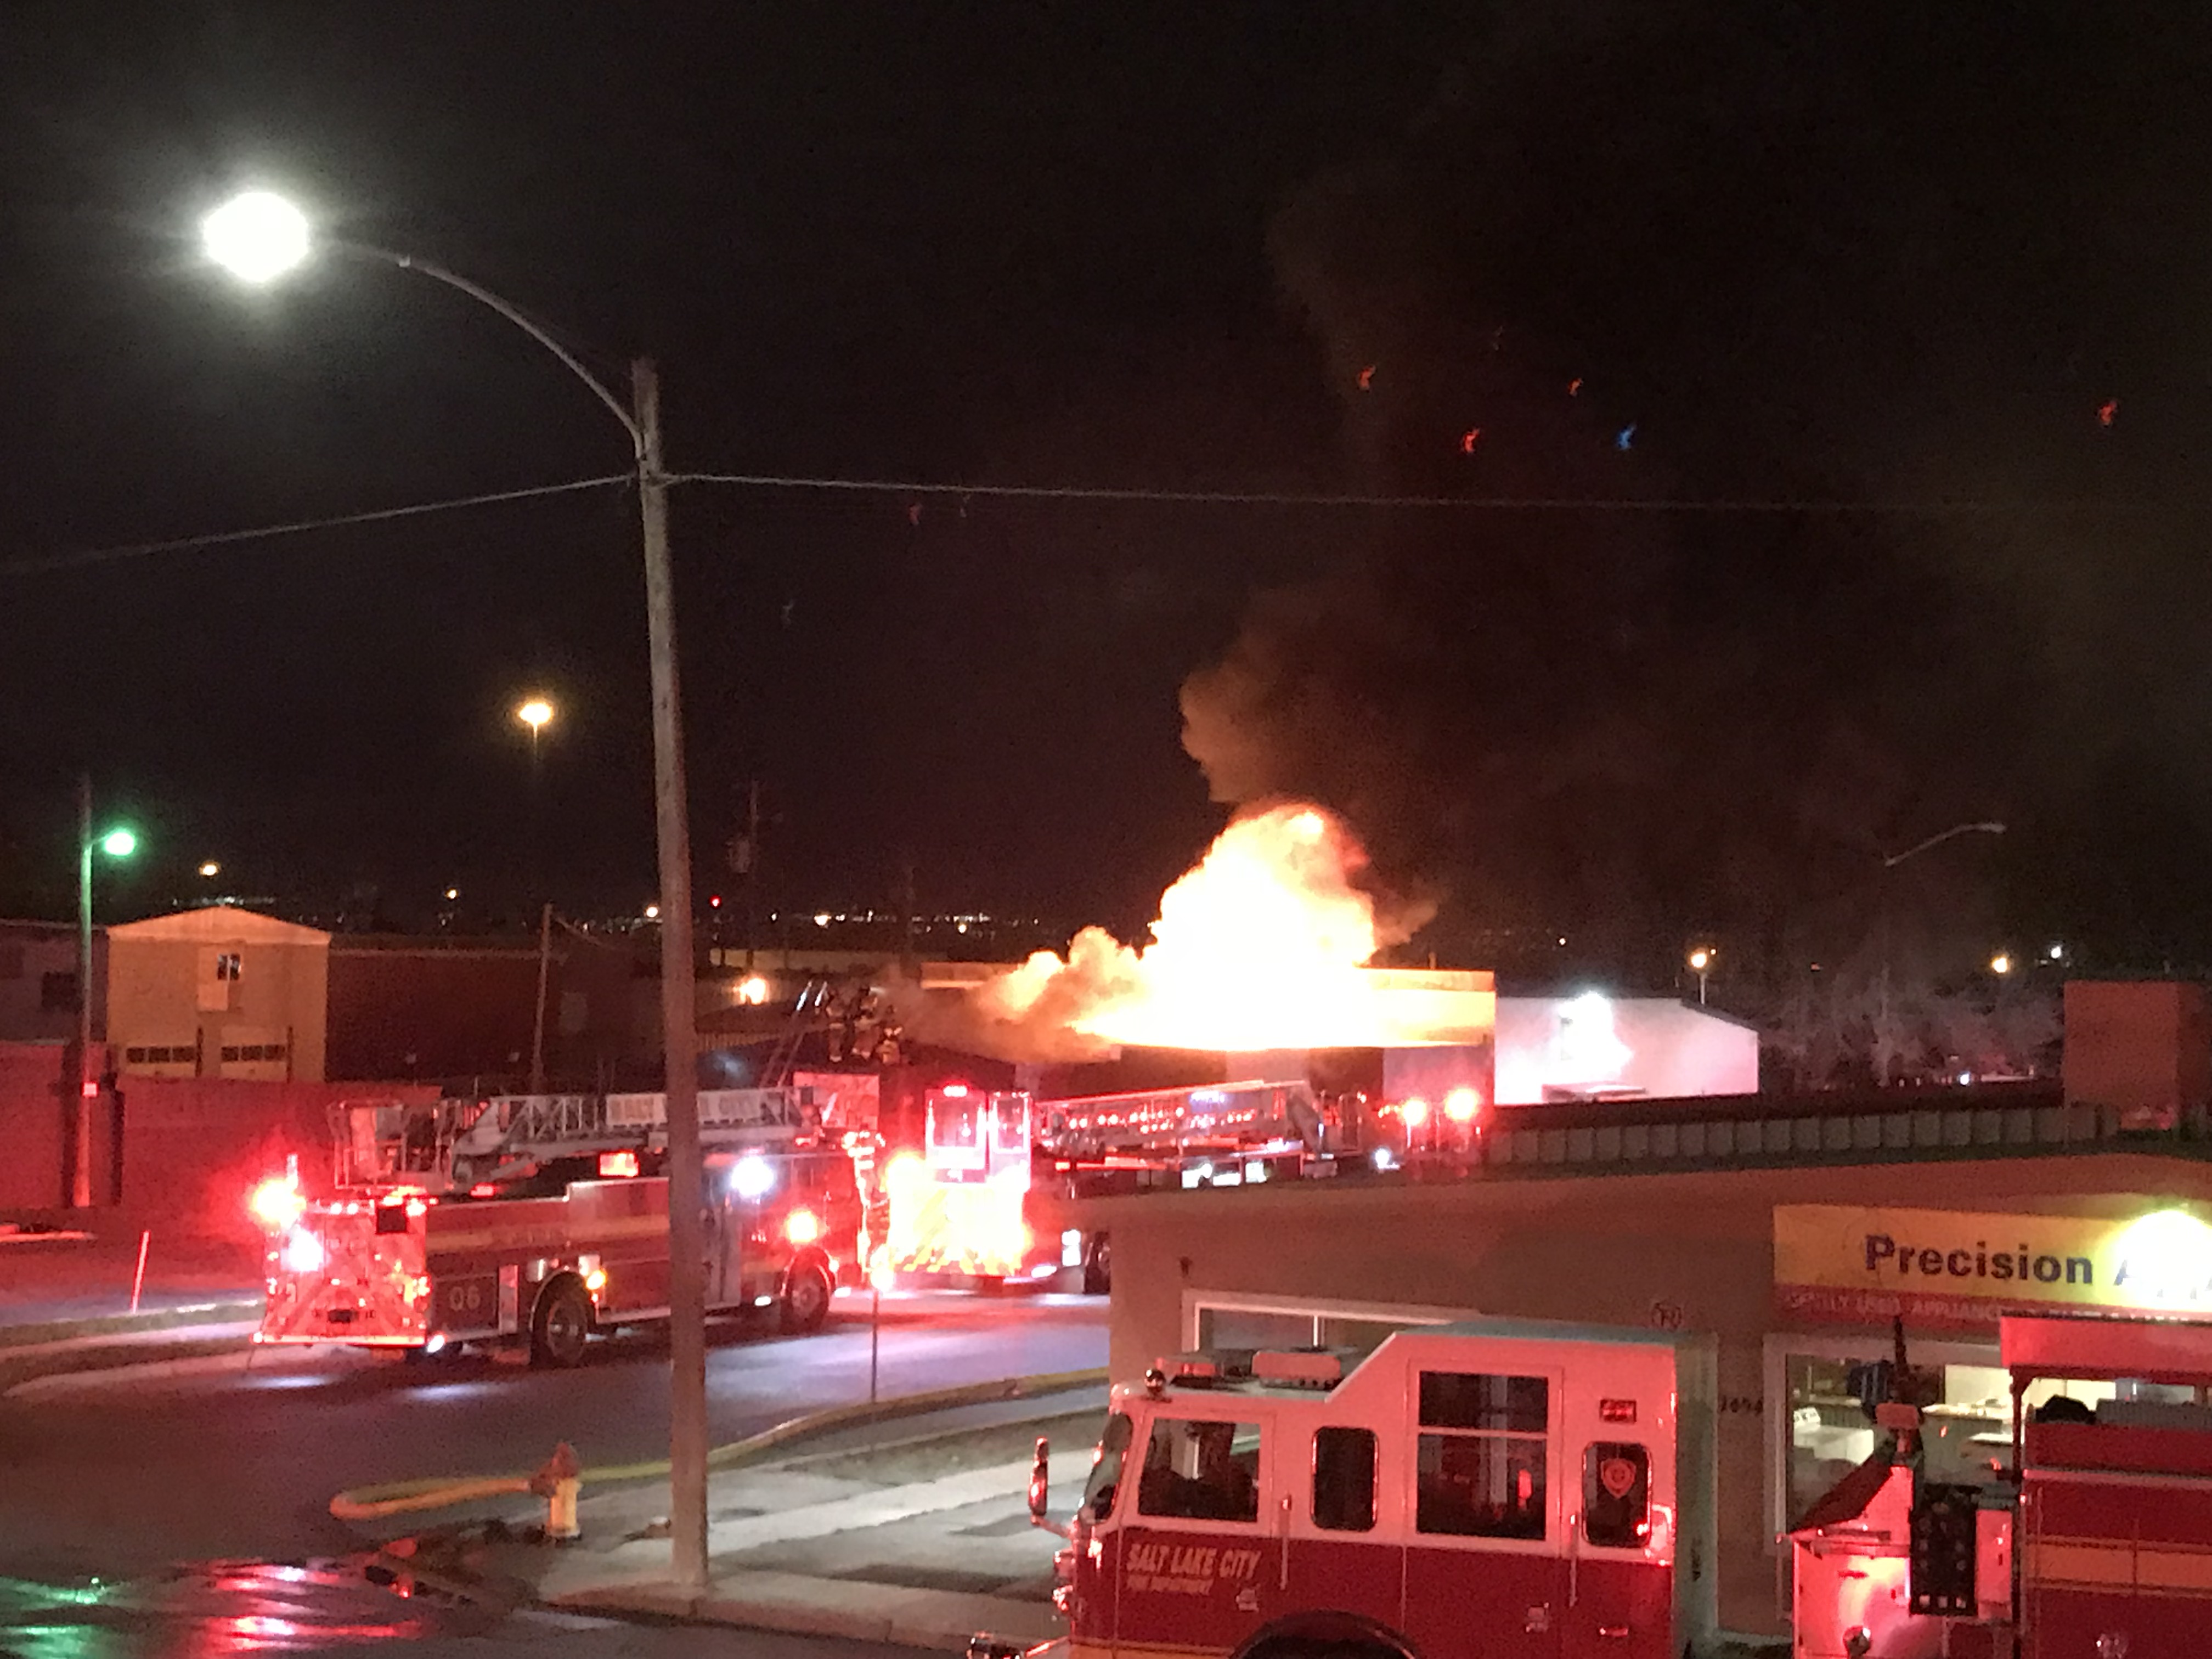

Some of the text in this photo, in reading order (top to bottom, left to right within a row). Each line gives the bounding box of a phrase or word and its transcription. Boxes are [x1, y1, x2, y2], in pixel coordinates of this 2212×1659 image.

[1865, 1234, 2094, 1284] Precision
[1126, 1543, 1261, 1579] SALT LAKE CITY
